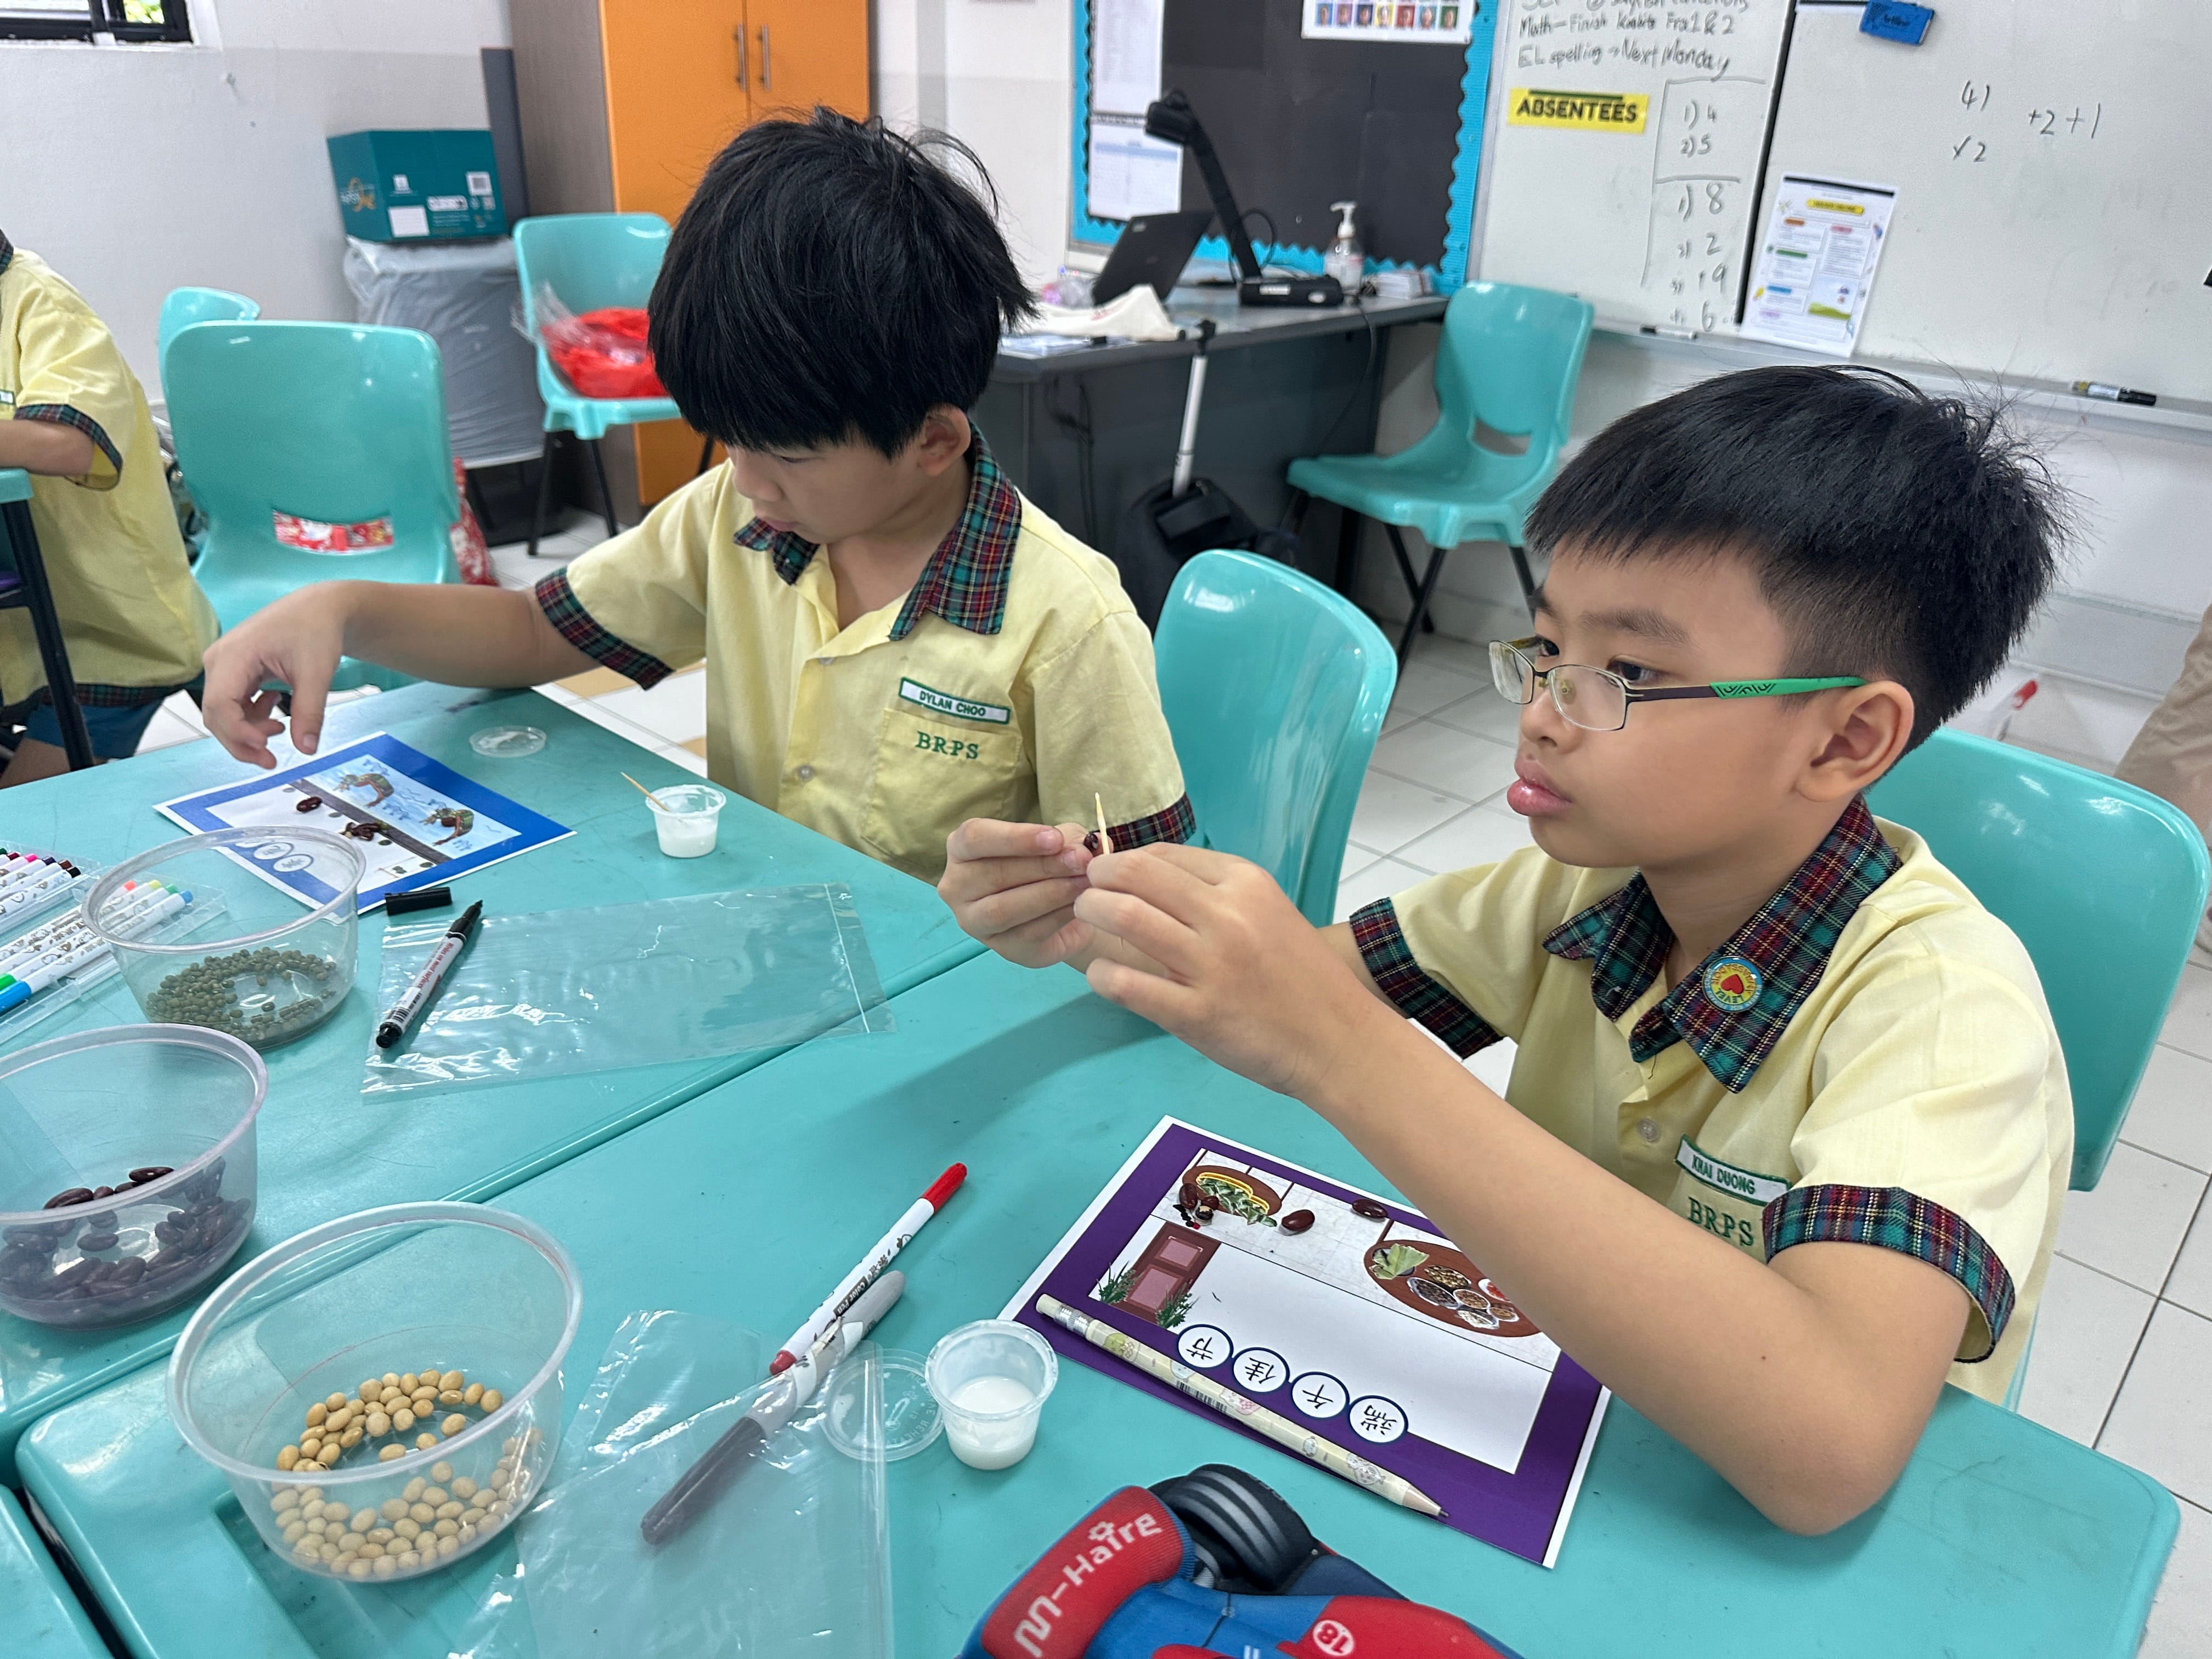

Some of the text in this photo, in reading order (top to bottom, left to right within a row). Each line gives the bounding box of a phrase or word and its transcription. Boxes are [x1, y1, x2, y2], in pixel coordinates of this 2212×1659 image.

[1516, 97, 1637, 124] ABSENTEES
[1705, 181, 1724, 215] 8
[919, 690, 987, 717] DYLAN CHOO
[915, 730, 979, 760] BRPS
[1716, 988, 1745, 1003] LEVEL
[1691, 1154, 1756, 1195] KHAI DUONG
[1688, 1196, 1754, 1246] BRPS
[837, 1282, 866, 1314] Color Pen
[1014, 1512, 1163, 1658] M-Haire
